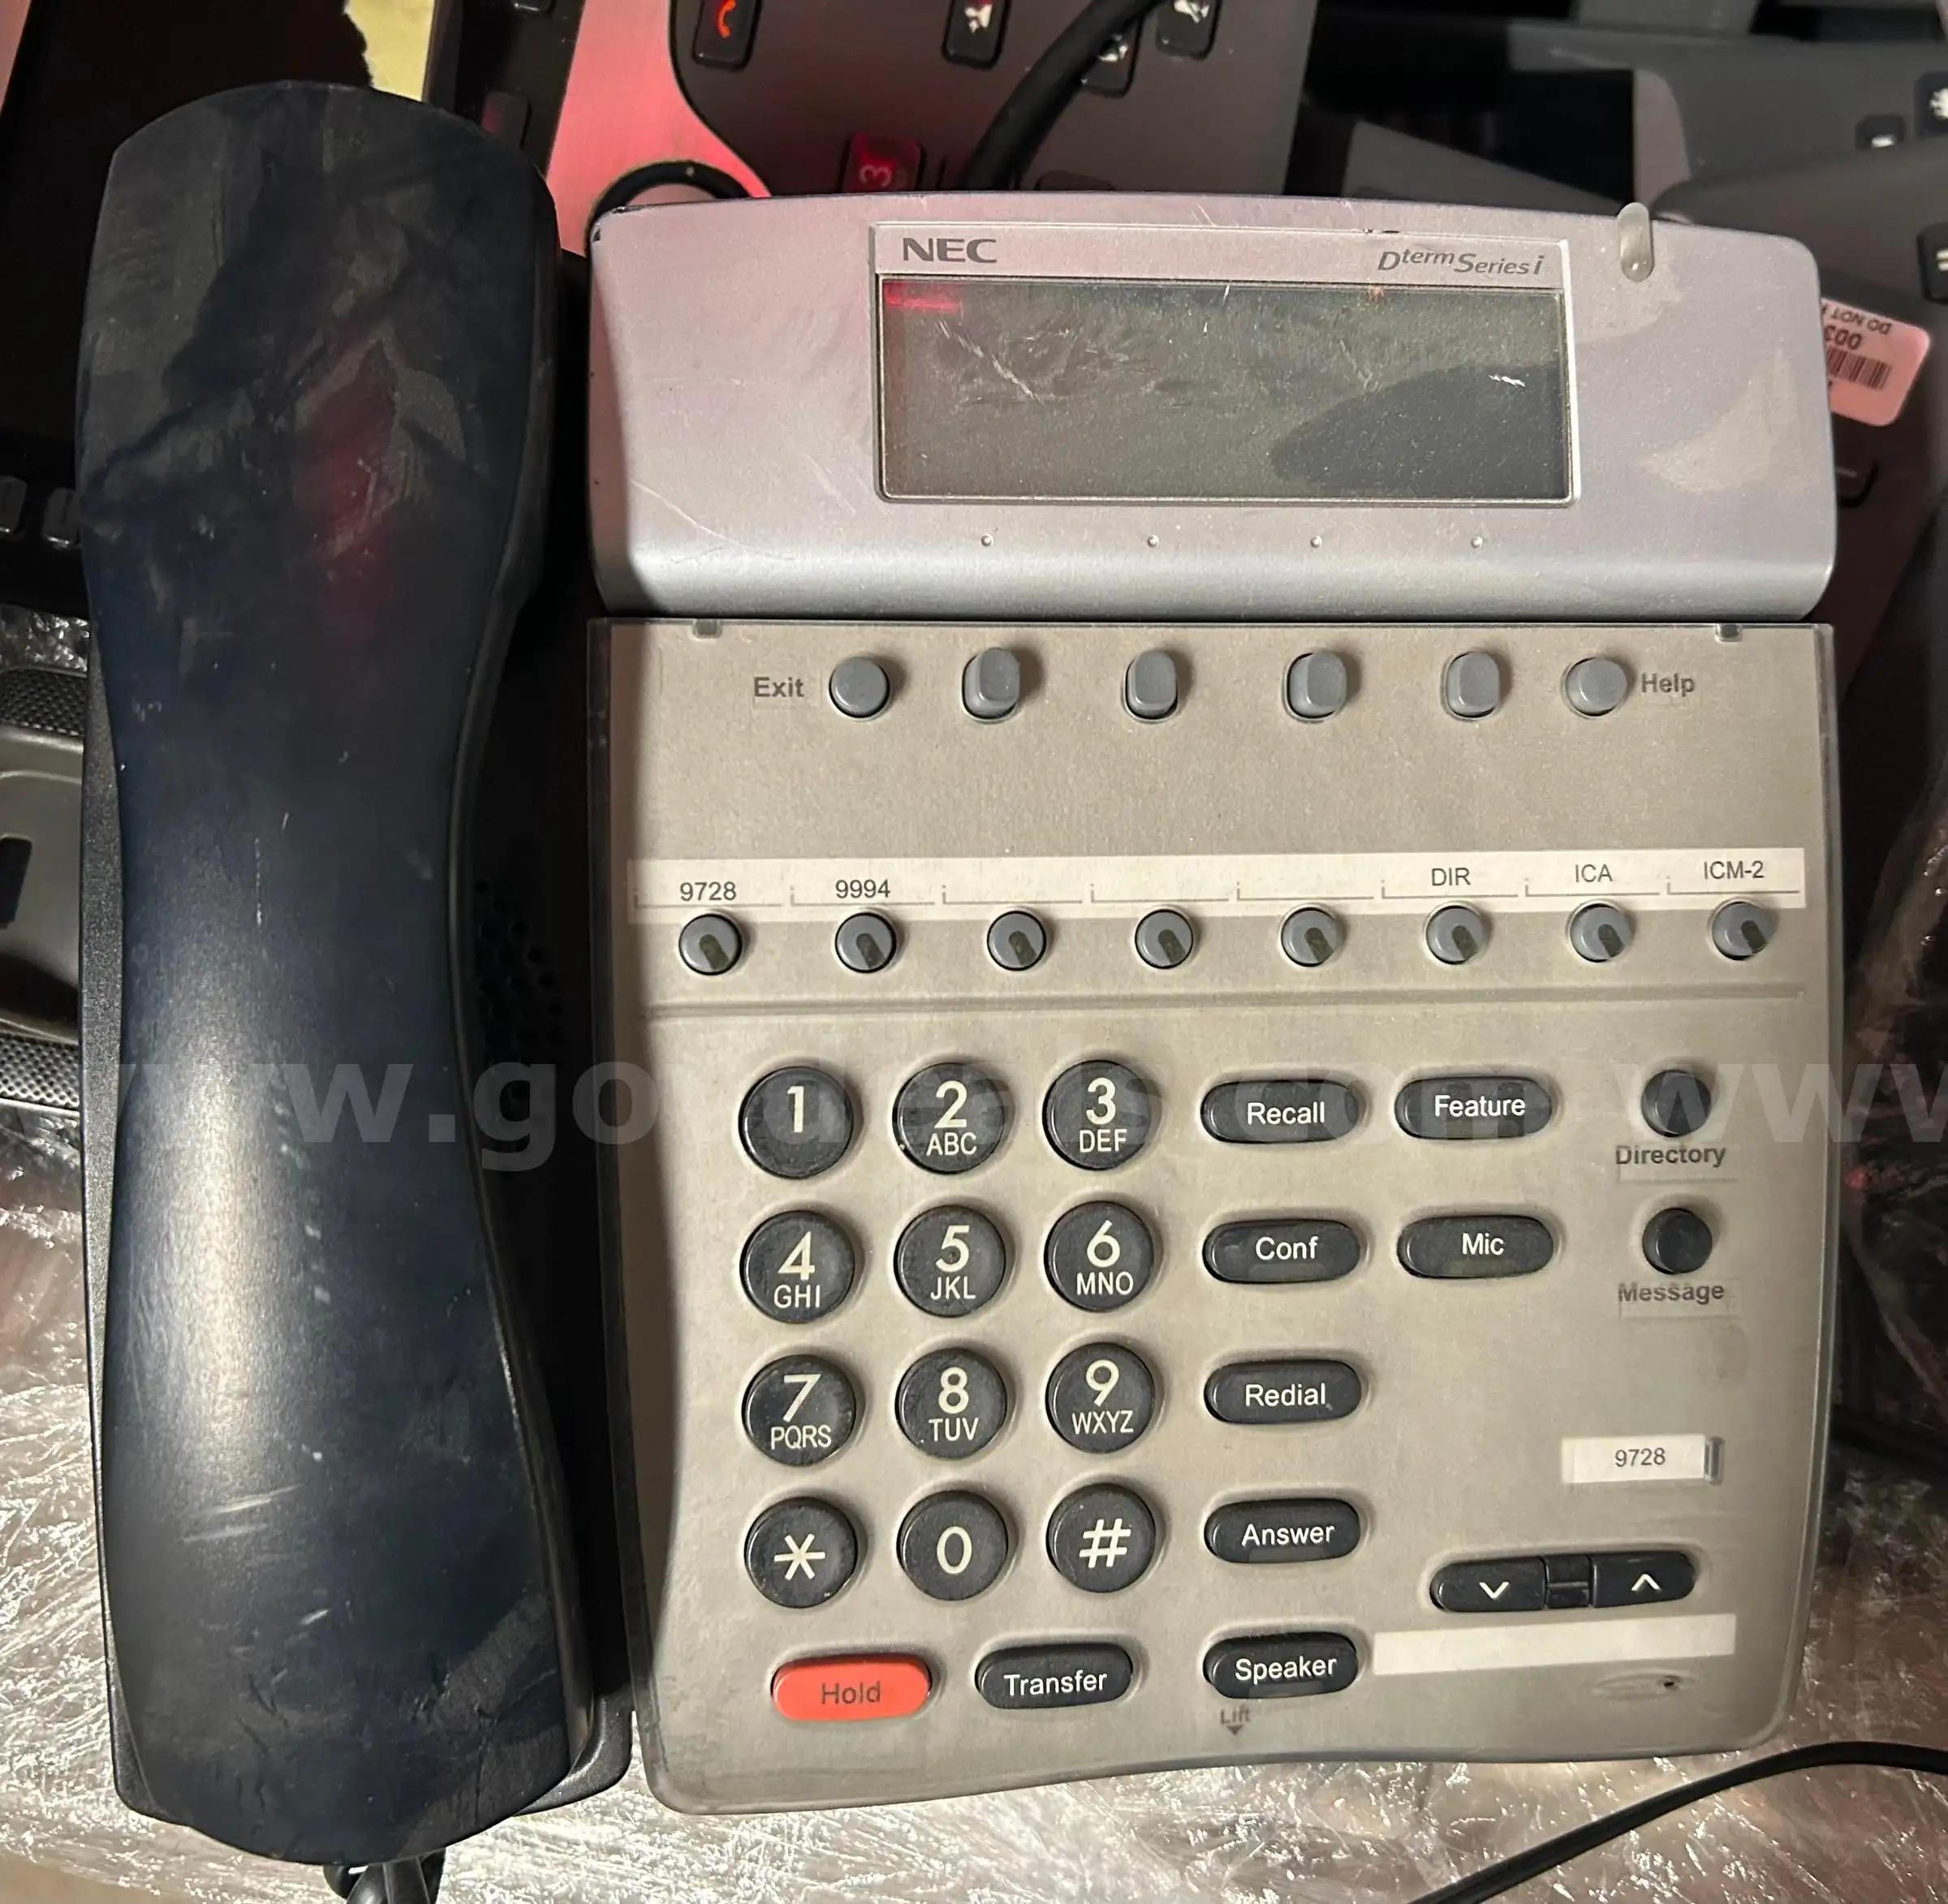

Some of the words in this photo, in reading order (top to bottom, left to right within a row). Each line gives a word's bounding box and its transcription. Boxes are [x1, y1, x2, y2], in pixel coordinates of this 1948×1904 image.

[860, 164, 892, 187] 3
[903, 238, 997, 263] NEC
[1377, 249, 1454, 270] Dterm
[1454, 253, 1529, 274] Series
[1832, 306, 1864, 326] NOT
[1867, 319, 1893, 335] DO
[754, 677, 804, 697] Exit
[1642, 673, 1695, 697] Help
[1432, 868, 1471, 886] DIR
[1575, 864, 1613, 882] ICA
[1704, 860, 1765, 879] ICM-2
[680, 881, 736, 901] 9728
[836, 880, 890, 898] 9994
[787, 1087, 804, 1133] 1
[934, 1081, 967, 1128] 2
[1087, 1078, 1115, 1124] 3
[1435, 1095, 1525, 1117] Feature
[1248, 1101, 1325, 1125] Recall
[927, 1132, 976, 1156] ABC
[1080, 1129, 1127, 1152] DEF
[1616, 1145, 1726, 1168] Directory
[936, 1226, 969, 1272] 5
[1087, 1221, 1120, 1267] 6
[1256, 1236, 1318, 1260] Conf
[1463, 1233, 1503, 1255] Mic
[778, 1231, 815, 1281] 4
[931, 1276, 976, 1299] JKL
[1077, 1272, 1133, 1294] MNO
[1618, 1283, 1726, 1305] Message
[774, 1285, 820, 1308] GHI
[939, 1368, 968, 1414] 8
[1086, 1360, 1118, 1406] 9
[1246, 1383, 1325, 1406] Redial
[783, 1374, 821, 1422] 7
[929, 1417, 978, 1441] TUV
[1072, 1411, 1133, 1434] WXYZ
[771, 1424, 831, 1450] PQRS
[1615, 1448, 1666, 1467] 9728
[1080, 1518, 1131, 1568] #
[1242, 1524, 1334, 1546] Answer
[937, 1527, 972, 1574] 0
[1235, 1656, 1337, 1682] Speaker
[821, 1681, 880, 1704] Hold
[1004, 1670, 1107, 1696] Transfer
[1221, 1708, 1250, 1725] Lift
